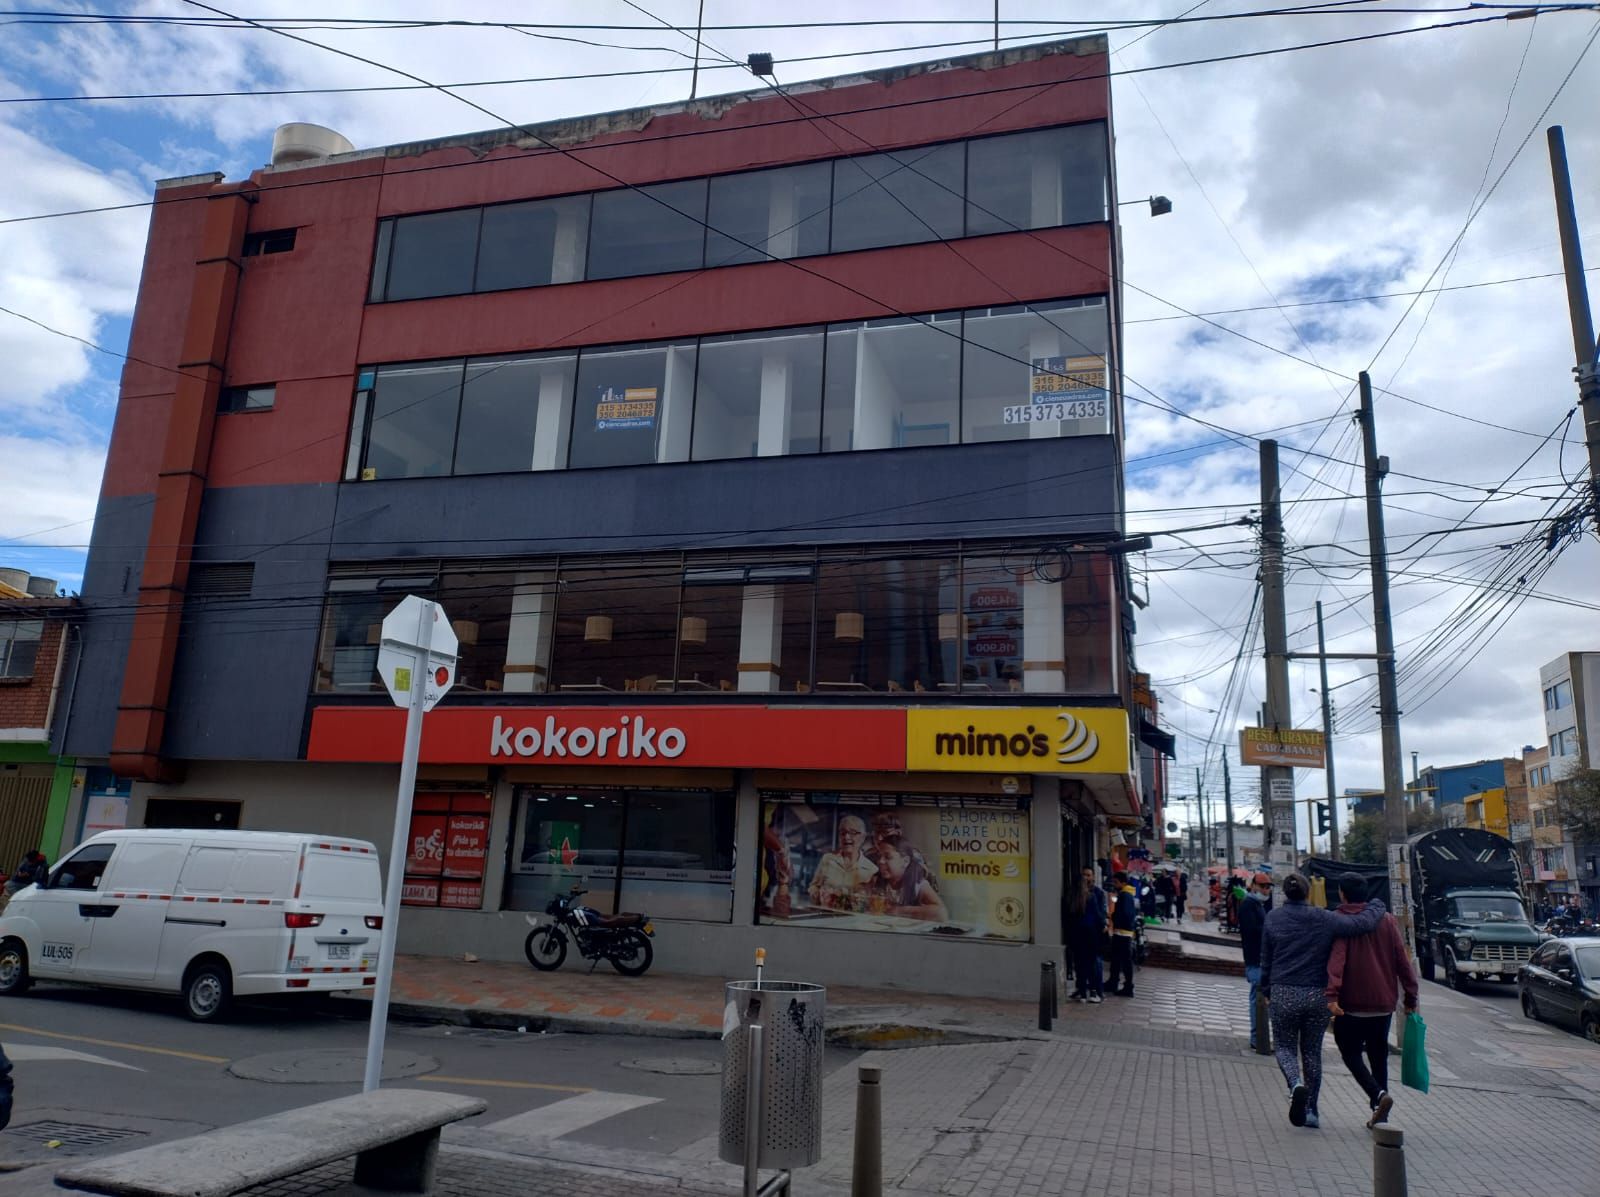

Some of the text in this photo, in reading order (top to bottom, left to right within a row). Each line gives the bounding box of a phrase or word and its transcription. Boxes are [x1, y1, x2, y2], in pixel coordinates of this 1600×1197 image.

[1006, 406, 1032, 423] 315
[1068, 401, 1105, 418] 4335
[490, 715, 687, 758] kokoriko
[935, 725, 1049, 757] mimo's
[960, 811, 998, 823] HORA
[940, 825, 1020, 839] DARTE UN
[940, 839, 1020, 854] MIMO CON
[945, 858, 1001, 877] mimo's
